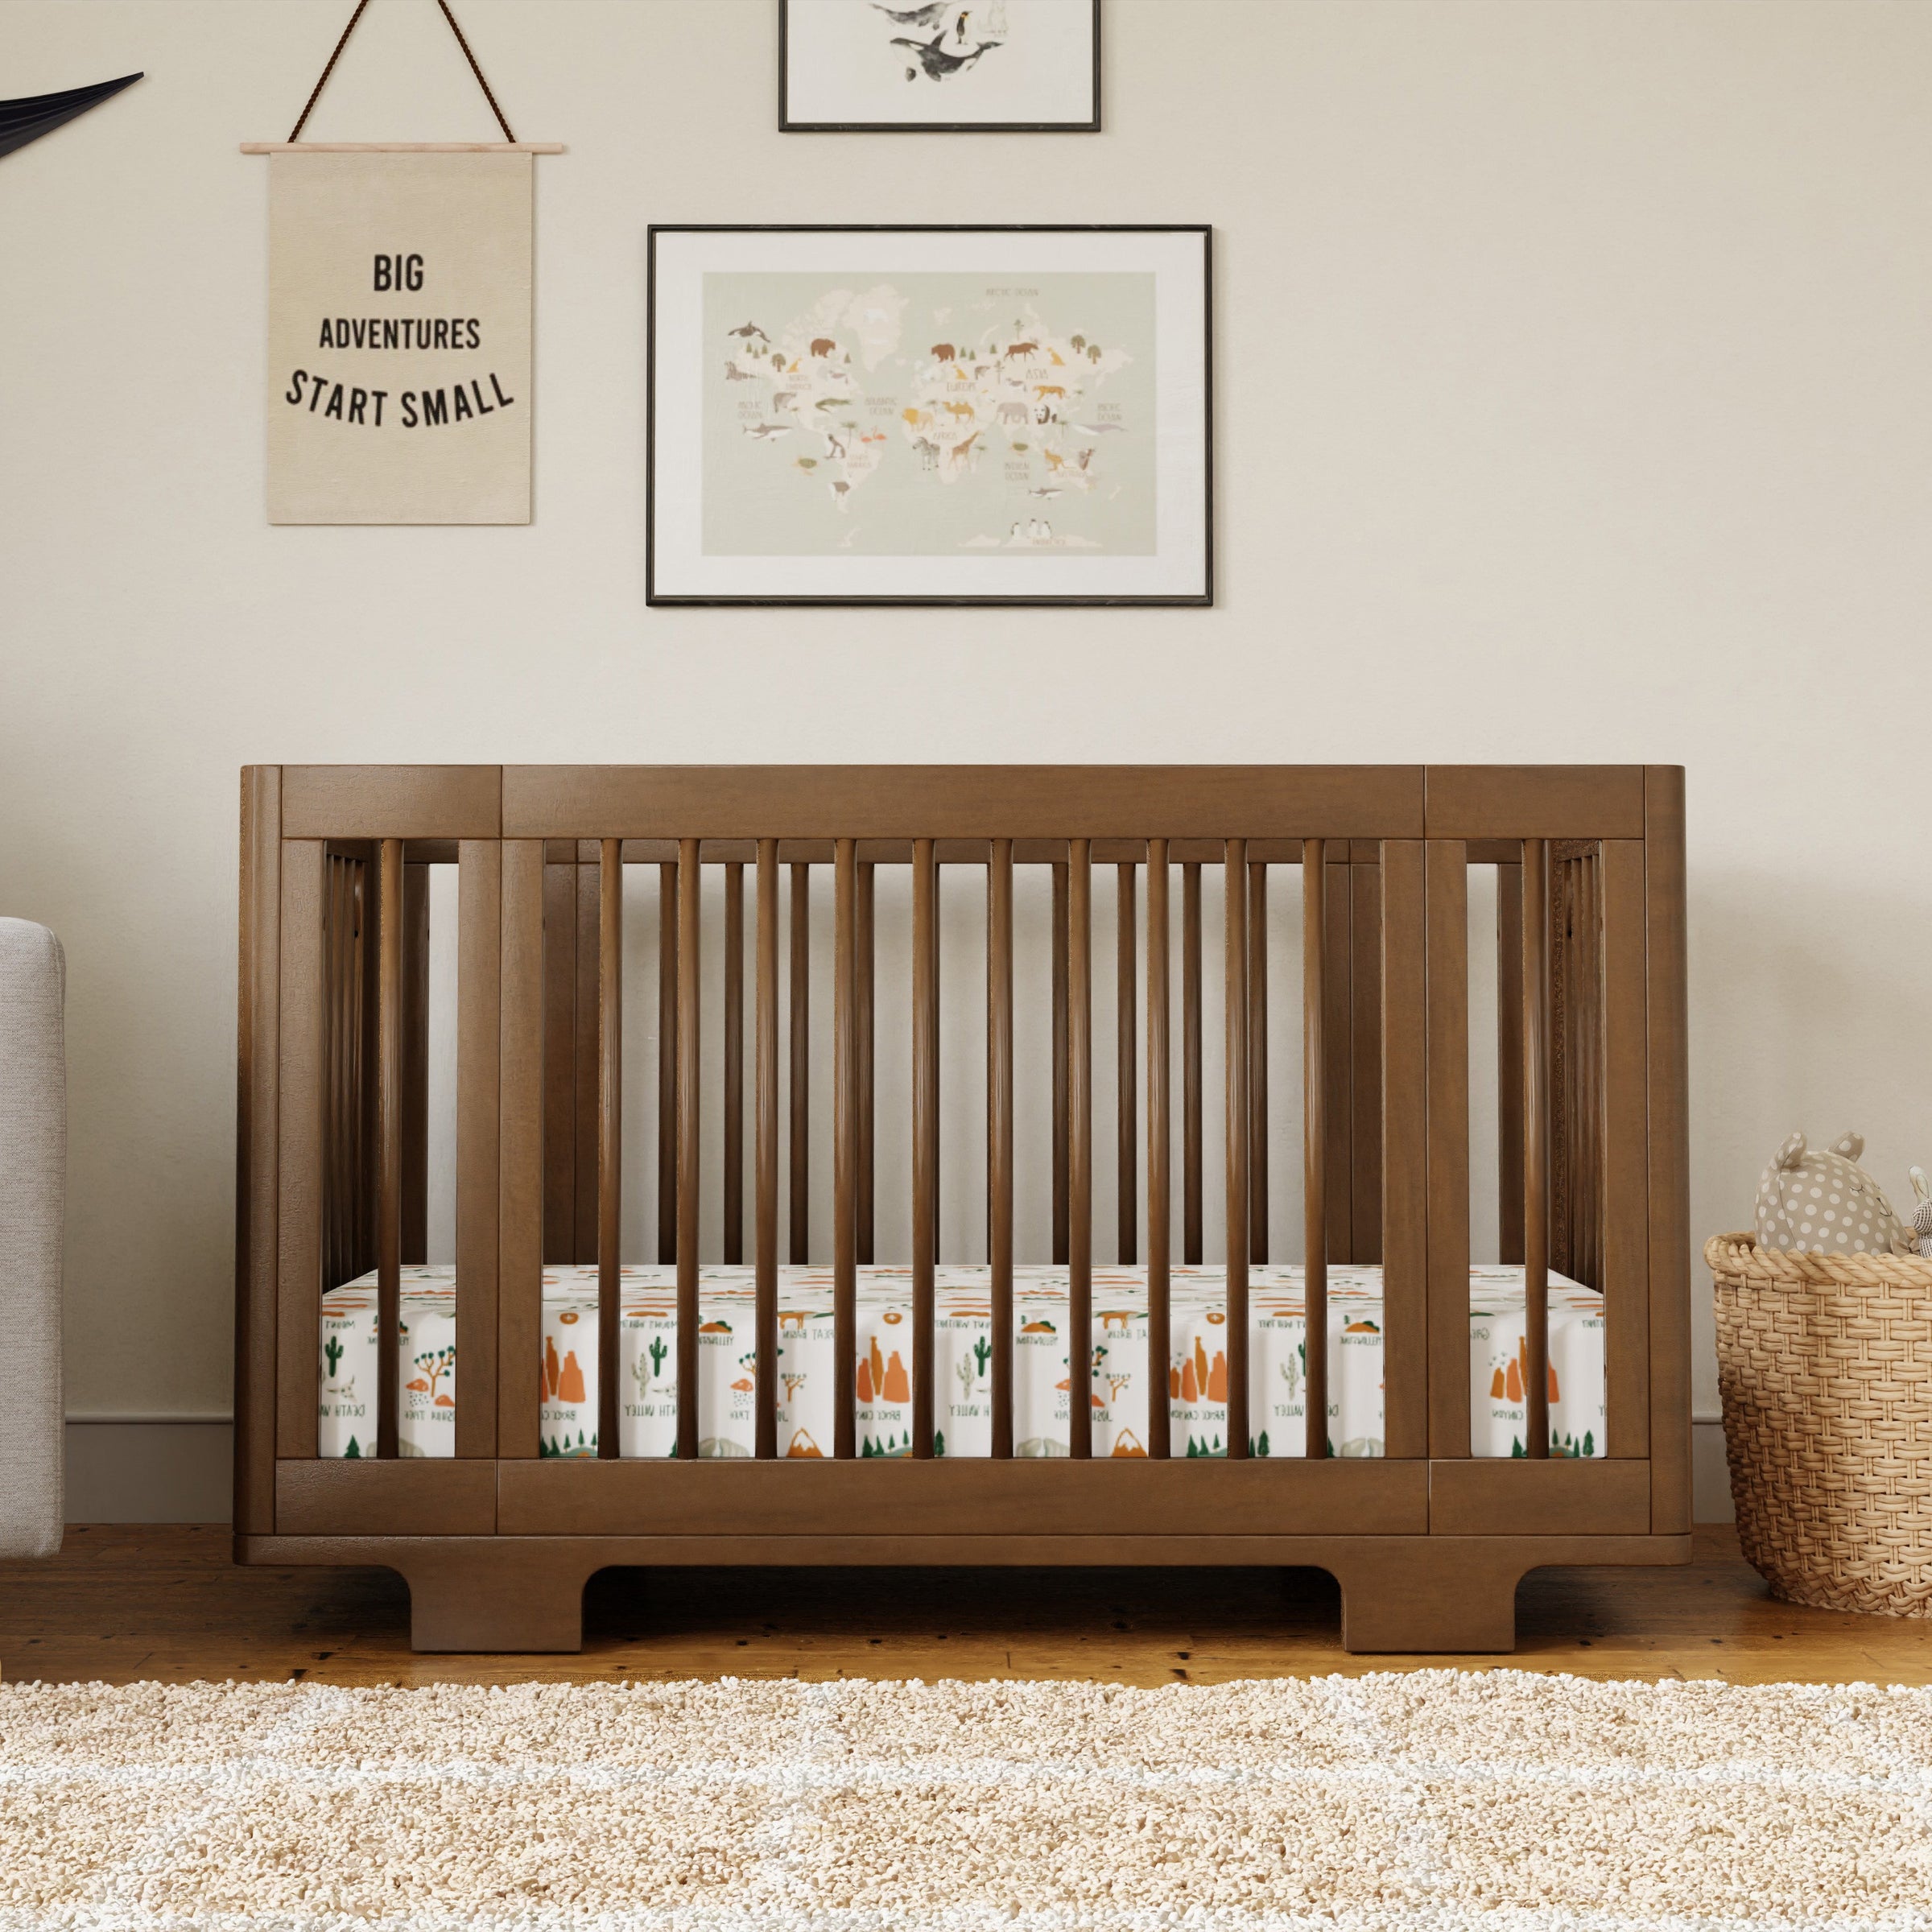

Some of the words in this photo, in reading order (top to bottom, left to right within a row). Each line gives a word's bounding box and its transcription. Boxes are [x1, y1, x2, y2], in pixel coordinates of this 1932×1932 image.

[374, 254, 424, 291] BIG
[320, 318, 481, 349] ADVENTURES
[1026, 369, 1048, 380] ASIA
[286, 369, 388, 427] START
[402, 373, 514, 428] SMALL
